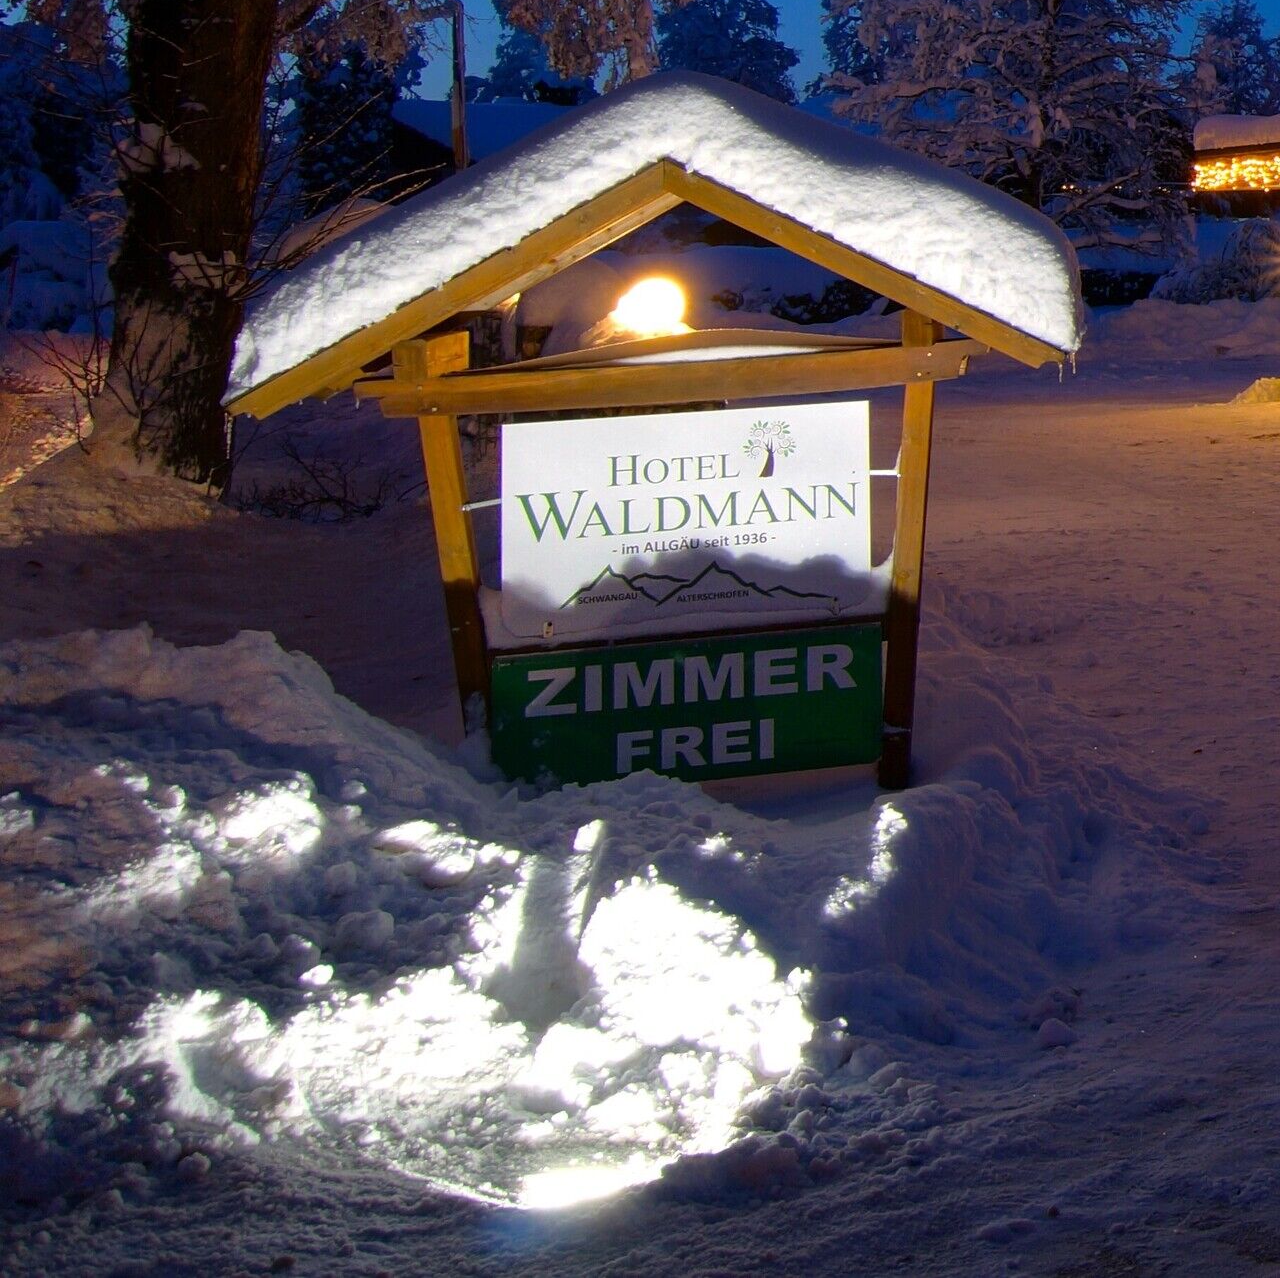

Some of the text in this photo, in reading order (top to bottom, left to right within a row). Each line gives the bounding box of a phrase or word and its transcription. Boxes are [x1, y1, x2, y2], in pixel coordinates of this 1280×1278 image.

[608, 453, 740, 487] HOTEL
[515, 481, 858, 543] WALDMANN
[621, 542, 640, 555] im
[644, 536, 700, 553] ALLGÄU
[704, 533, 730, 548] seit
[734, 532, 768, 547] 1936
[578, 591, 639, 605] SCHWANGAU
[676, 589, 750, 604] ALTERSCHROFEN
[525, 643, 858, 719] ZIMMER
[616, 717, 776, 775] FREI
